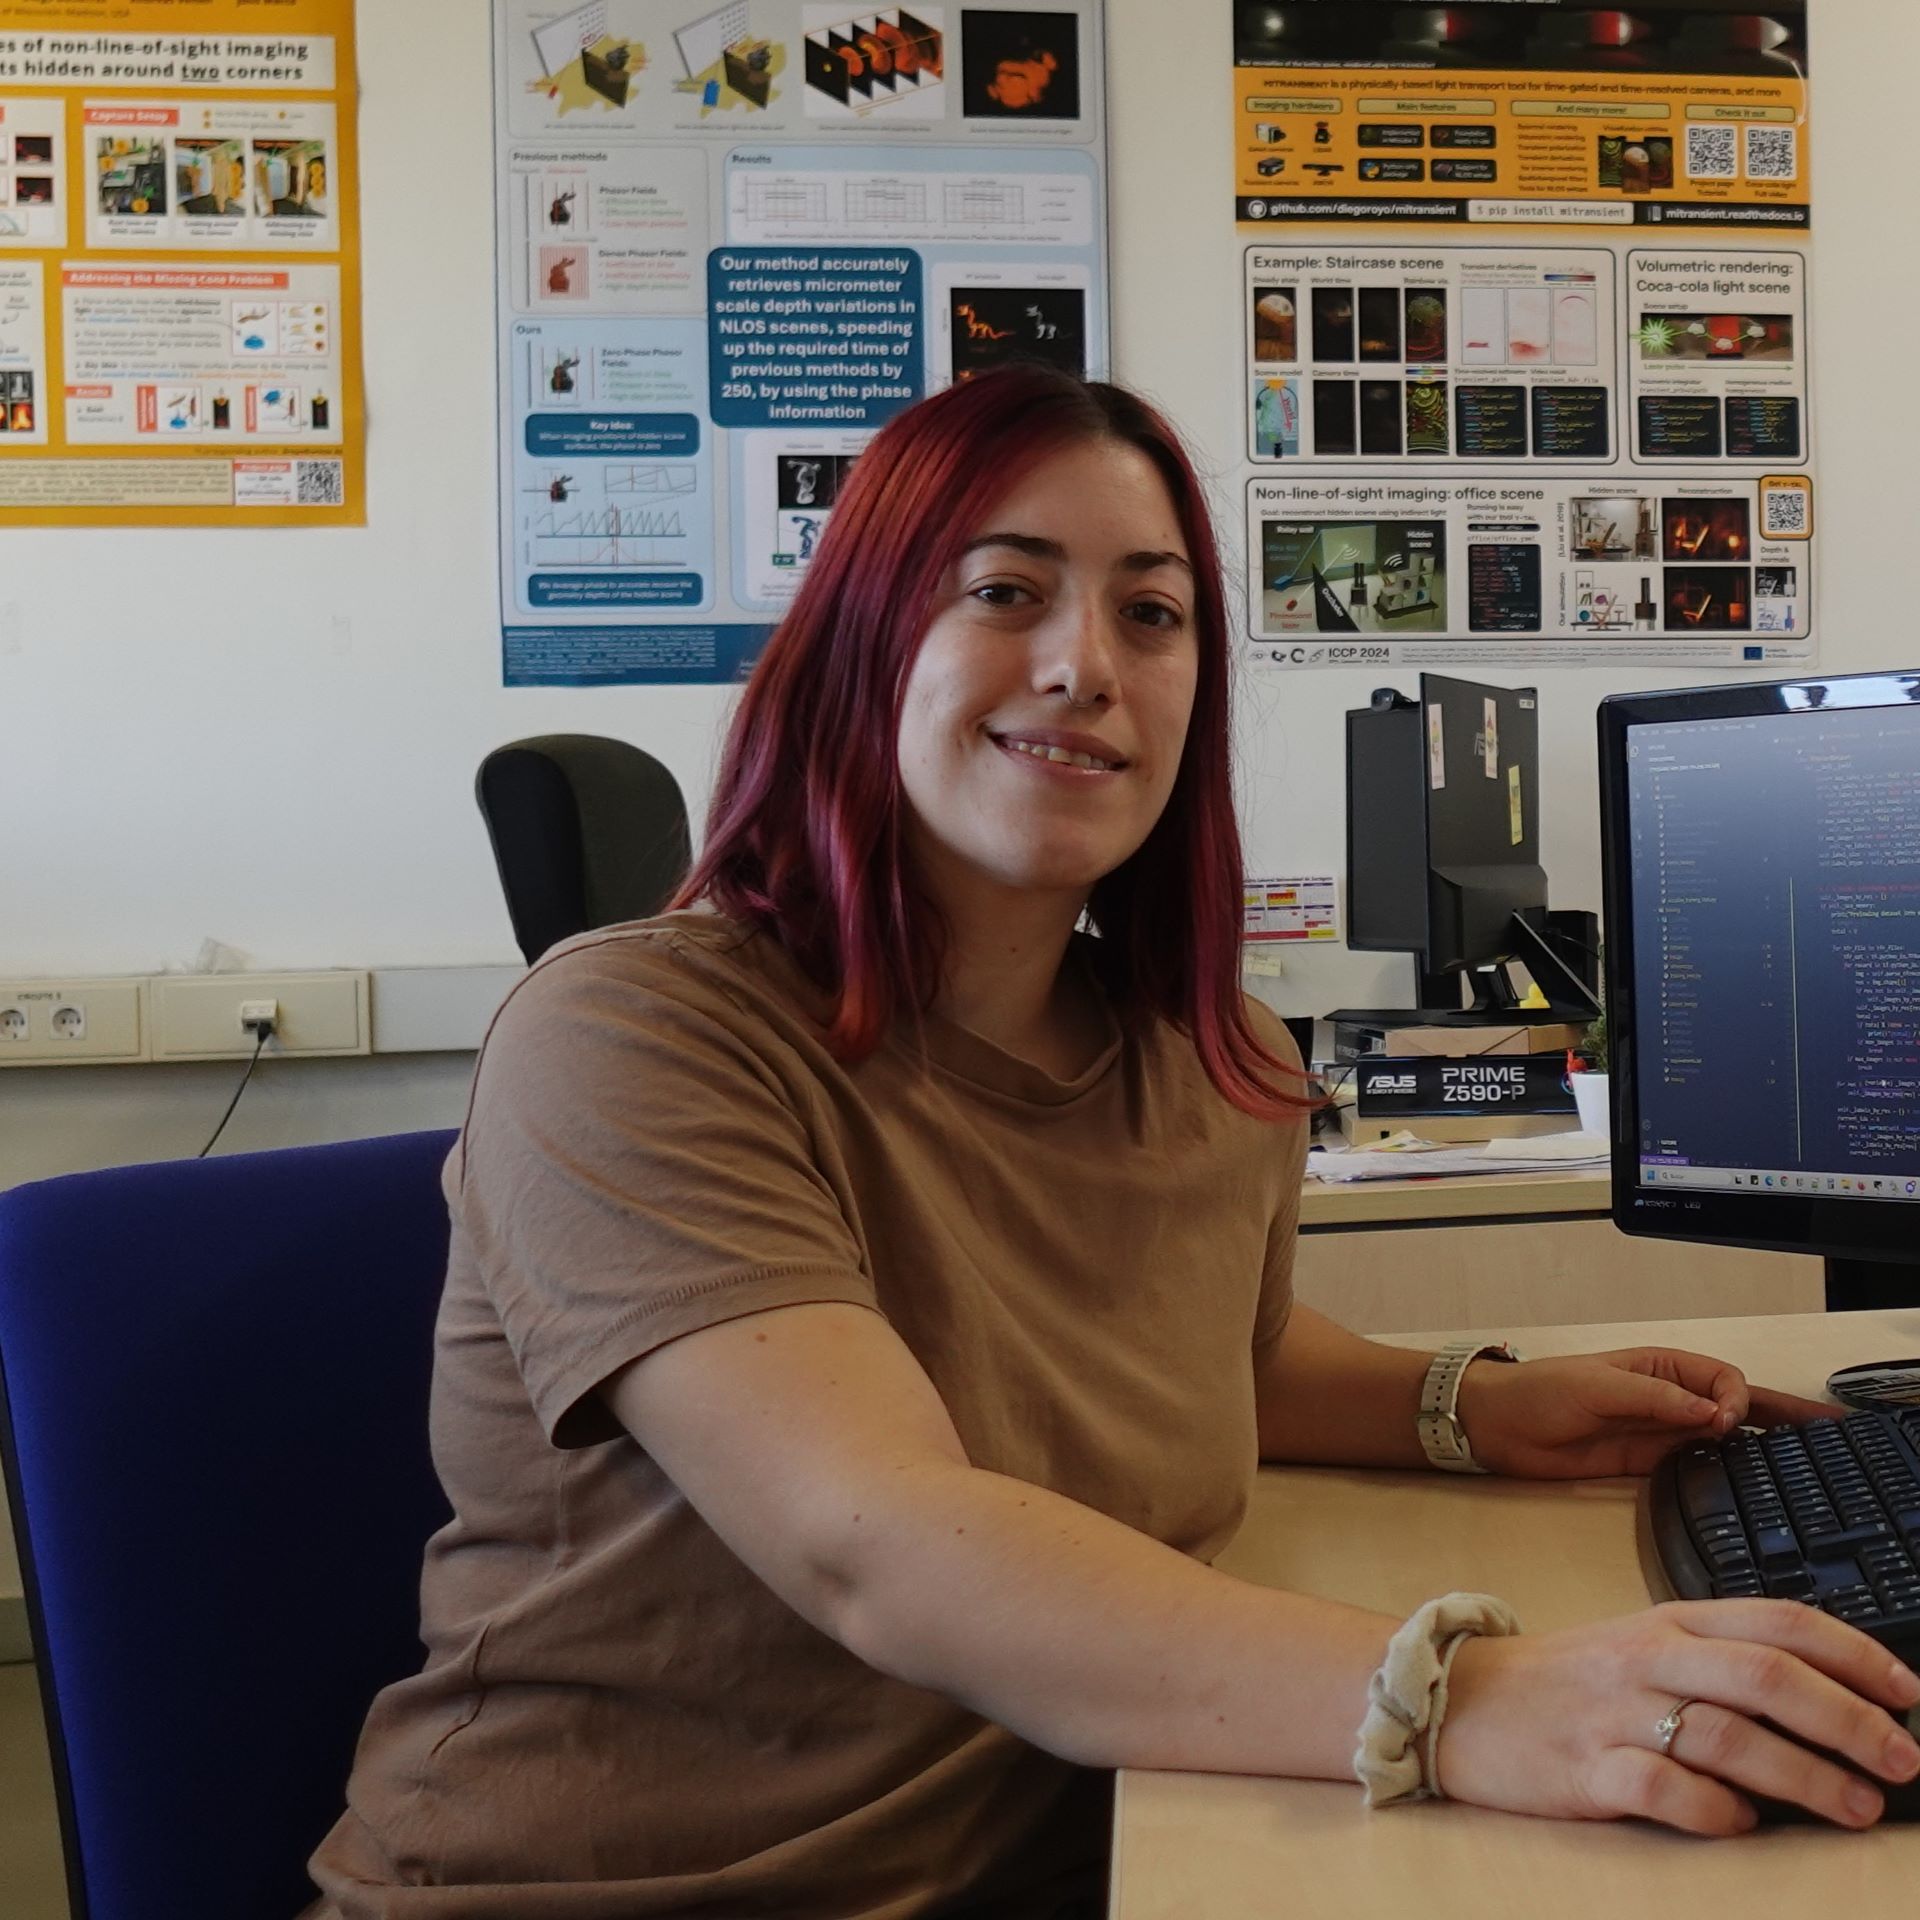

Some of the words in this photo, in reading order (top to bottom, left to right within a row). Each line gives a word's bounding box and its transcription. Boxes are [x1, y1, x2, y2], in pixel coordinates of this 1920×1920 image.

[24, 39, 44, 53] of
[51, 38, 221, 59] non-line-of-sight
[227, 42, 308, 60] imaging
[25, 61, 94, 76] hidden
[102, 62, 173, 77] around
[182, 65, 219, 80] two
[227, 66, 303, 80] corners
[1435, 81, 1456, 91] light
[1459, 81, 1505, 91] transport
[1508, 82, 1525, 91] tool
[1528, 82, 1541, 91] for
[1544, 83, 1598, 93] time-gated
[1600, 84, 1618, 92] and
[1736, 87, 1754, 96] and
[1756, 88, 1781, 96] more
[1254, 101, 1290, 112] Imaging
[1292, 102, 1334, 111] hardware
[1397, 102, 1418, 111] Main
[1420, 102, 1456, 112] features
[1556, 105, 1575, 113] And
[1576, 107, 1600, 115] many
[1715, 108, 1739, 118] Check
[513, 152, 558, 161] Previous
[561, 152, 607, 161] methods
[733, 155, 771, 164] Results
[599, 186, 629, 195] Phasor
[1271, 203, 1456, 216] github.com/diegoroyo/mitransient
[1477, 203, 1484, 215] $
[1489, 204, 1507, 217] pip
[1513, 206, 1554, 217] install
[1560, 207, 1625, 217] mitransient
[1666, 209, 1804, 222] mitransient.readthedocs.io
[628, 250, 658, 258] Phasor
[720, 256, 751, 270] Our
[755, 256, 818, 270] method
[822, 257, 909, 274] accurately
[1254, 256, 1321, 270] Example:
[1326, 257, 1396, 270] Staircase
[1400, 259, 1444, 270] scene
[1637, 260, 1715, 273] Volumetric
[1720, 261, 1793, 277] rendering:
[729, 278, 801, 292] retrieves
[805, 278, 902, 292] micrometer
[1637, 280, 1709, 293] Coca-cola
[1713, 281, 1745, 295] light
[1749, 283, 1790, 293] scene
[716, 300, 760, 313] scale
[764, 300, 811, 316] depth
[815, 301, 896, 313] variations
[900, 302, 915, 313] in
[516, 325, 542, 335] Ours
[720, 320, 765, 334] NLOS
[770, 322, 833, 336] scenes,
[838, 321, 912, 337] speeding
[724, 345, 745, 358] up
[748, 342, 776, 355] the
[779, 342, 848, 358] required
[852, 342, 889, 355] time
[893, 342, 909, 355] of
[732, 363, 802, 379] previous
[806, 363, 878, 377] methods
[882, 363, 902, 380] by
[722, 384, 757, 398] 250,
[760, 384, 779, 400] by
[783, 385, 828, 401] using
[830, 384, 857, 398] the
[861, 385, 912, 401] phase
[769, 405, 866, 419] information
[590, 421, 608, 431] Key
[1256, 487, 1384, 502] Non-line-of-sight
[1388, 487, 1451, 502] imaging:
[1455, 487, 1497, 500] office
[1500, 490, 1544, 500] scene
[1467, 504, 1497, 512] Running
[1407, 531, 1434, 539] Hidden
[1329, 647, 1358, 658] ICCP
[1360, 647, 1390, 658] 2024
[1367, 1075, 1417, 1088] ASUS
[1441, 1066, 1526, 1083] PRIME
[1443, 1085, 1526, 1102] Z590-P
